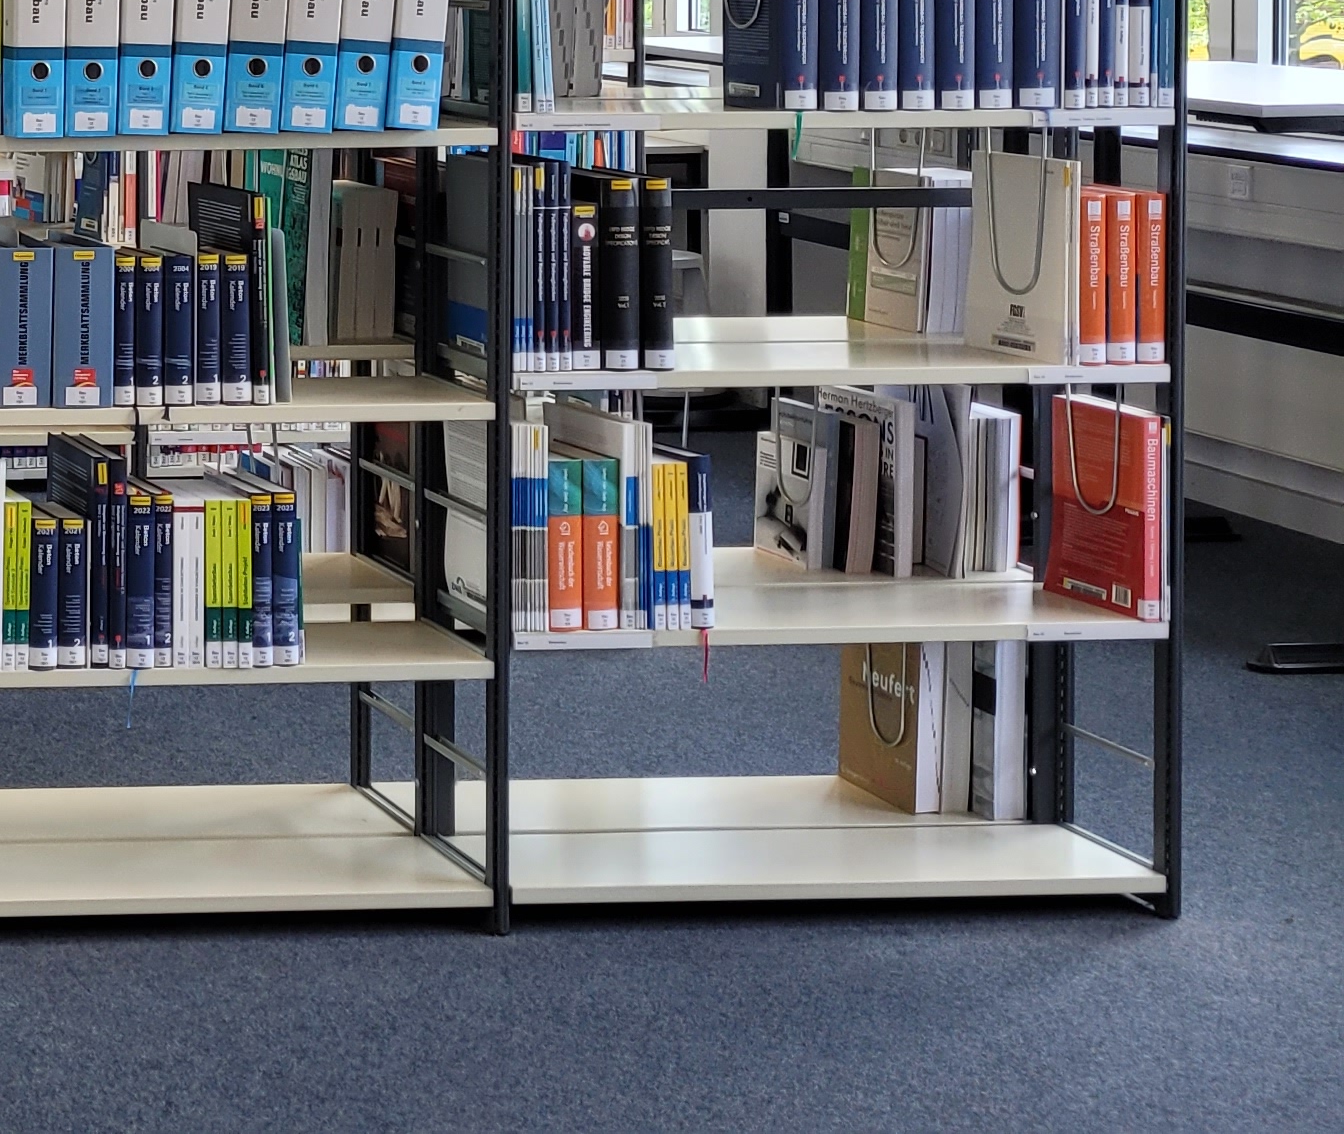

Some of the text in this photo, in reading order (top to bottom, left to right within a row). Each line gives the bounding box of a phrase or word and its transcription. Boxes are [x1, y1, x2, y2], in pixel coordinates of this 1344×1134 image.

[1090, 225, 1100, 288] Straßenbau
[1120, 224, 1130, 288] Straßenbau
[1150, 224, 1161, 287] Straßenbau
[18, 262, 28, 365] MERKBLATTSAMMLUNG
[80, 262, 90, 364] MERKBLATTSAMMLUNG
[130, 377, 134, 386] 1
[152, 376, 159, 384] 2
[182, 376, 188, 384] 2
[213, 374, 218, 383] 1
[819, 387, 849, 405] Herman
[1147, 438, 1158, 522] Baumaschinen
[145, 635, 151, 645] 1
[165, 633, 171, 643] 2
[267, 632, 271, 642] 1
[289, 632, 295, 642] 2
[48, 639, 53, 648] 1
[74, 638, 81, 647] 2
